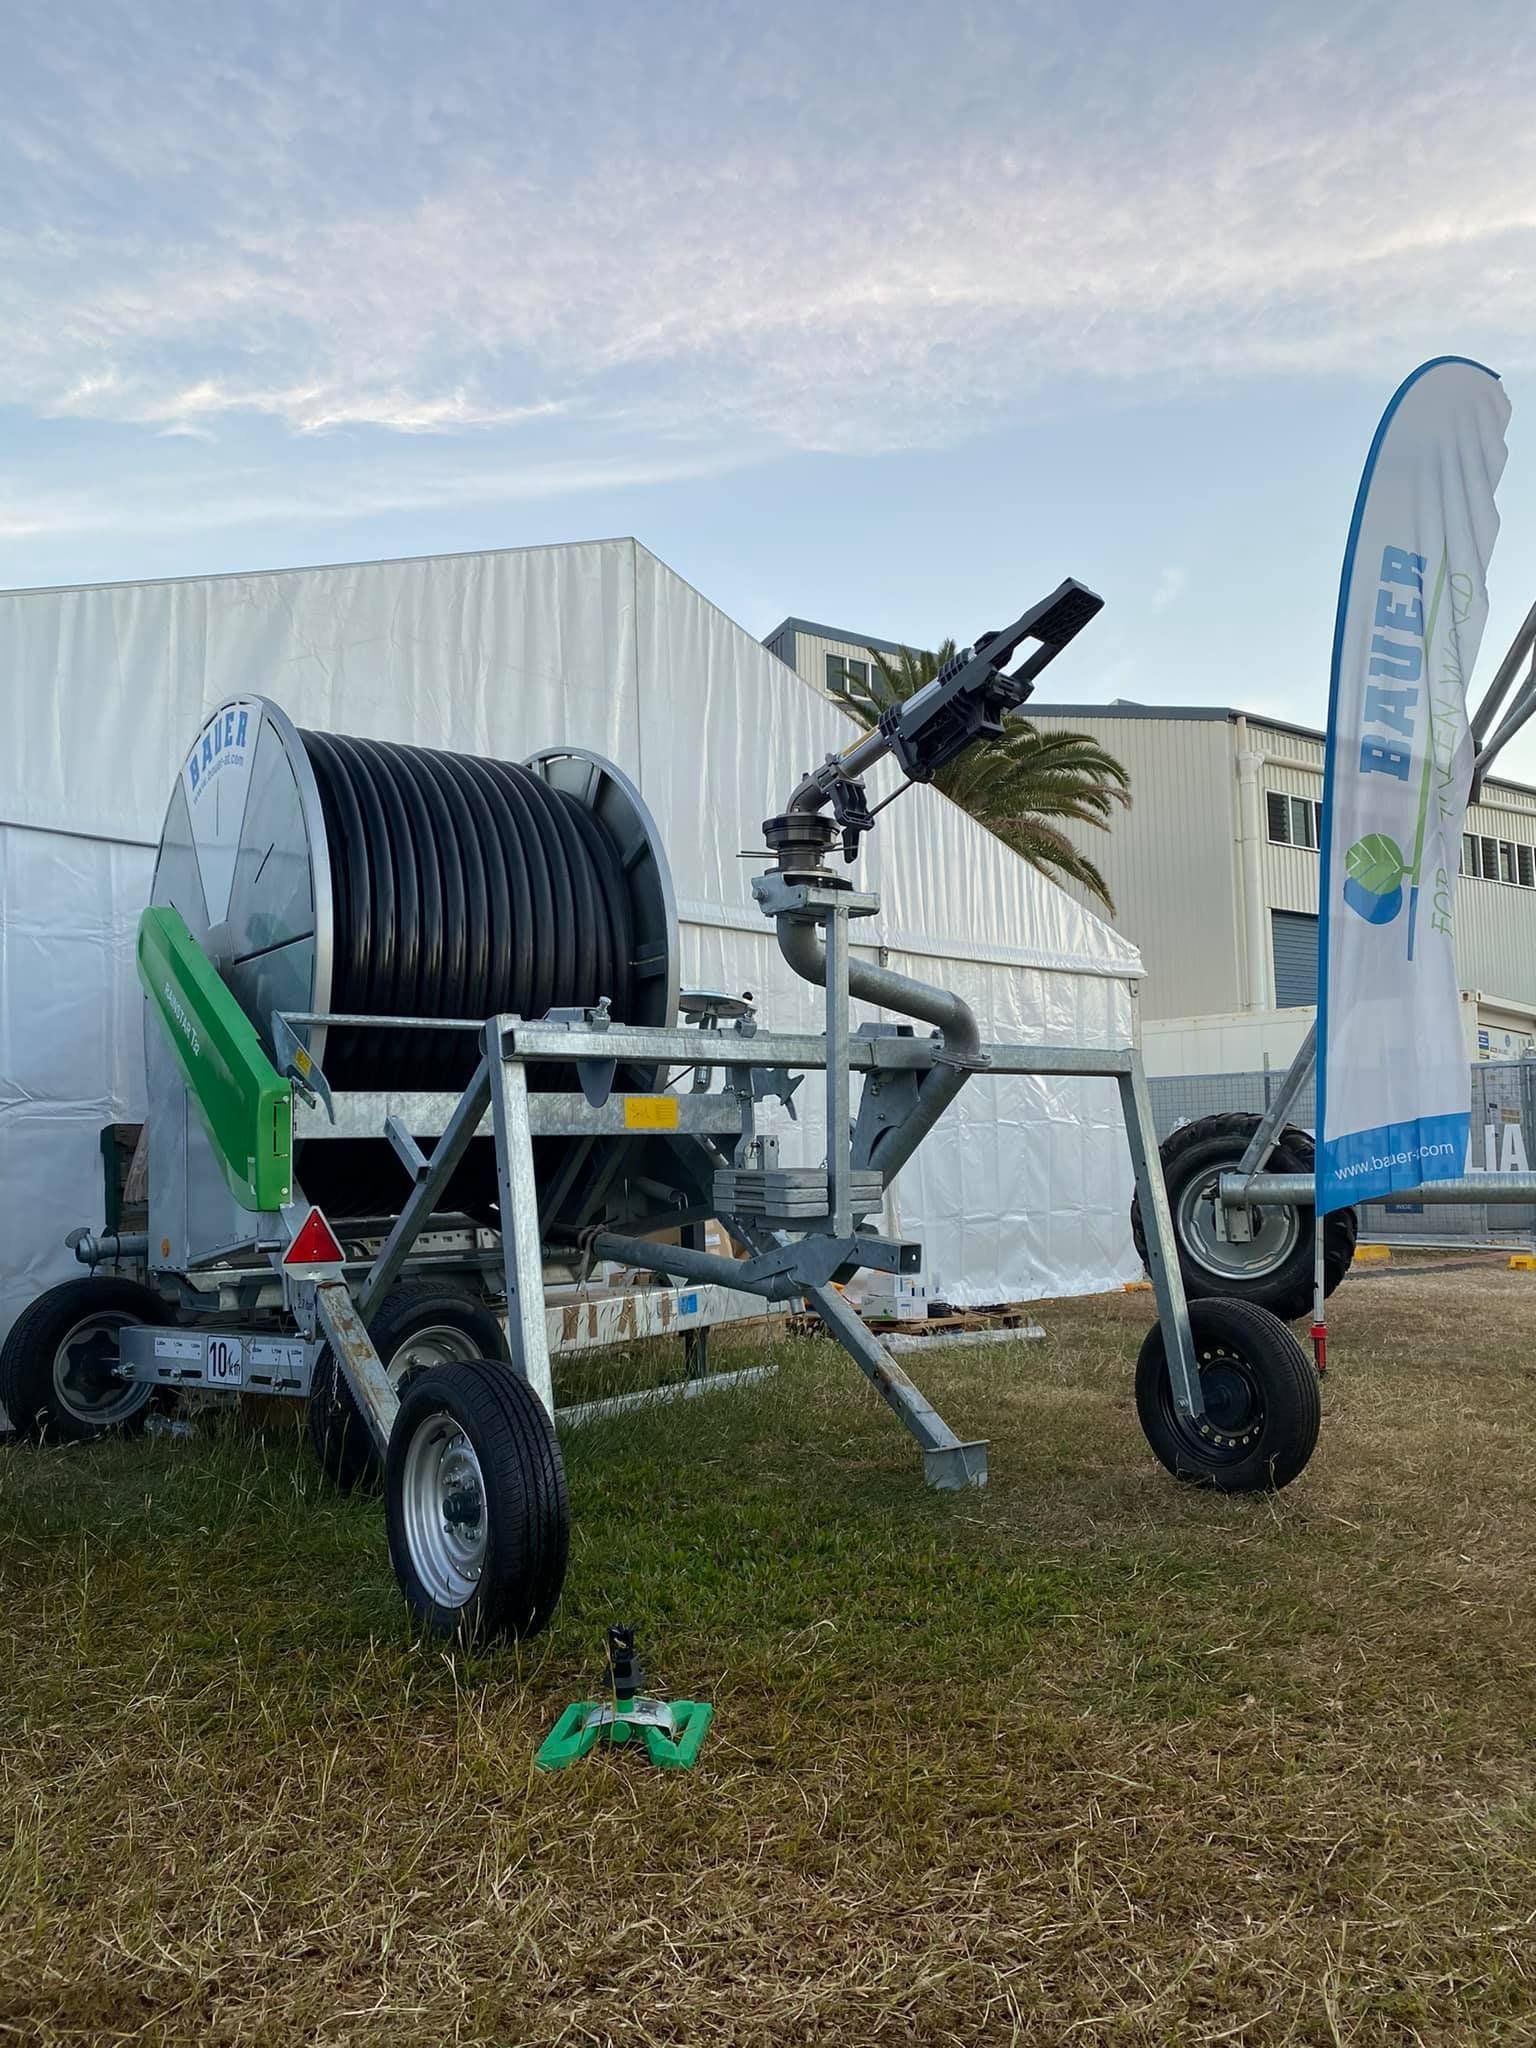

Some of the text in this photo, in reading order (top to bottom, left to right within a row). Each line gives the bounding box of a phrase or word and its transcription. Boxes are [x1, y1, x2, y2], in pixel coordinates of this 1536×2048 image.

[1360, 545, 1427, 781] BAUER
[190, 711, 248, 792] BAUER
[209, 1341, 227, 1378] 10
